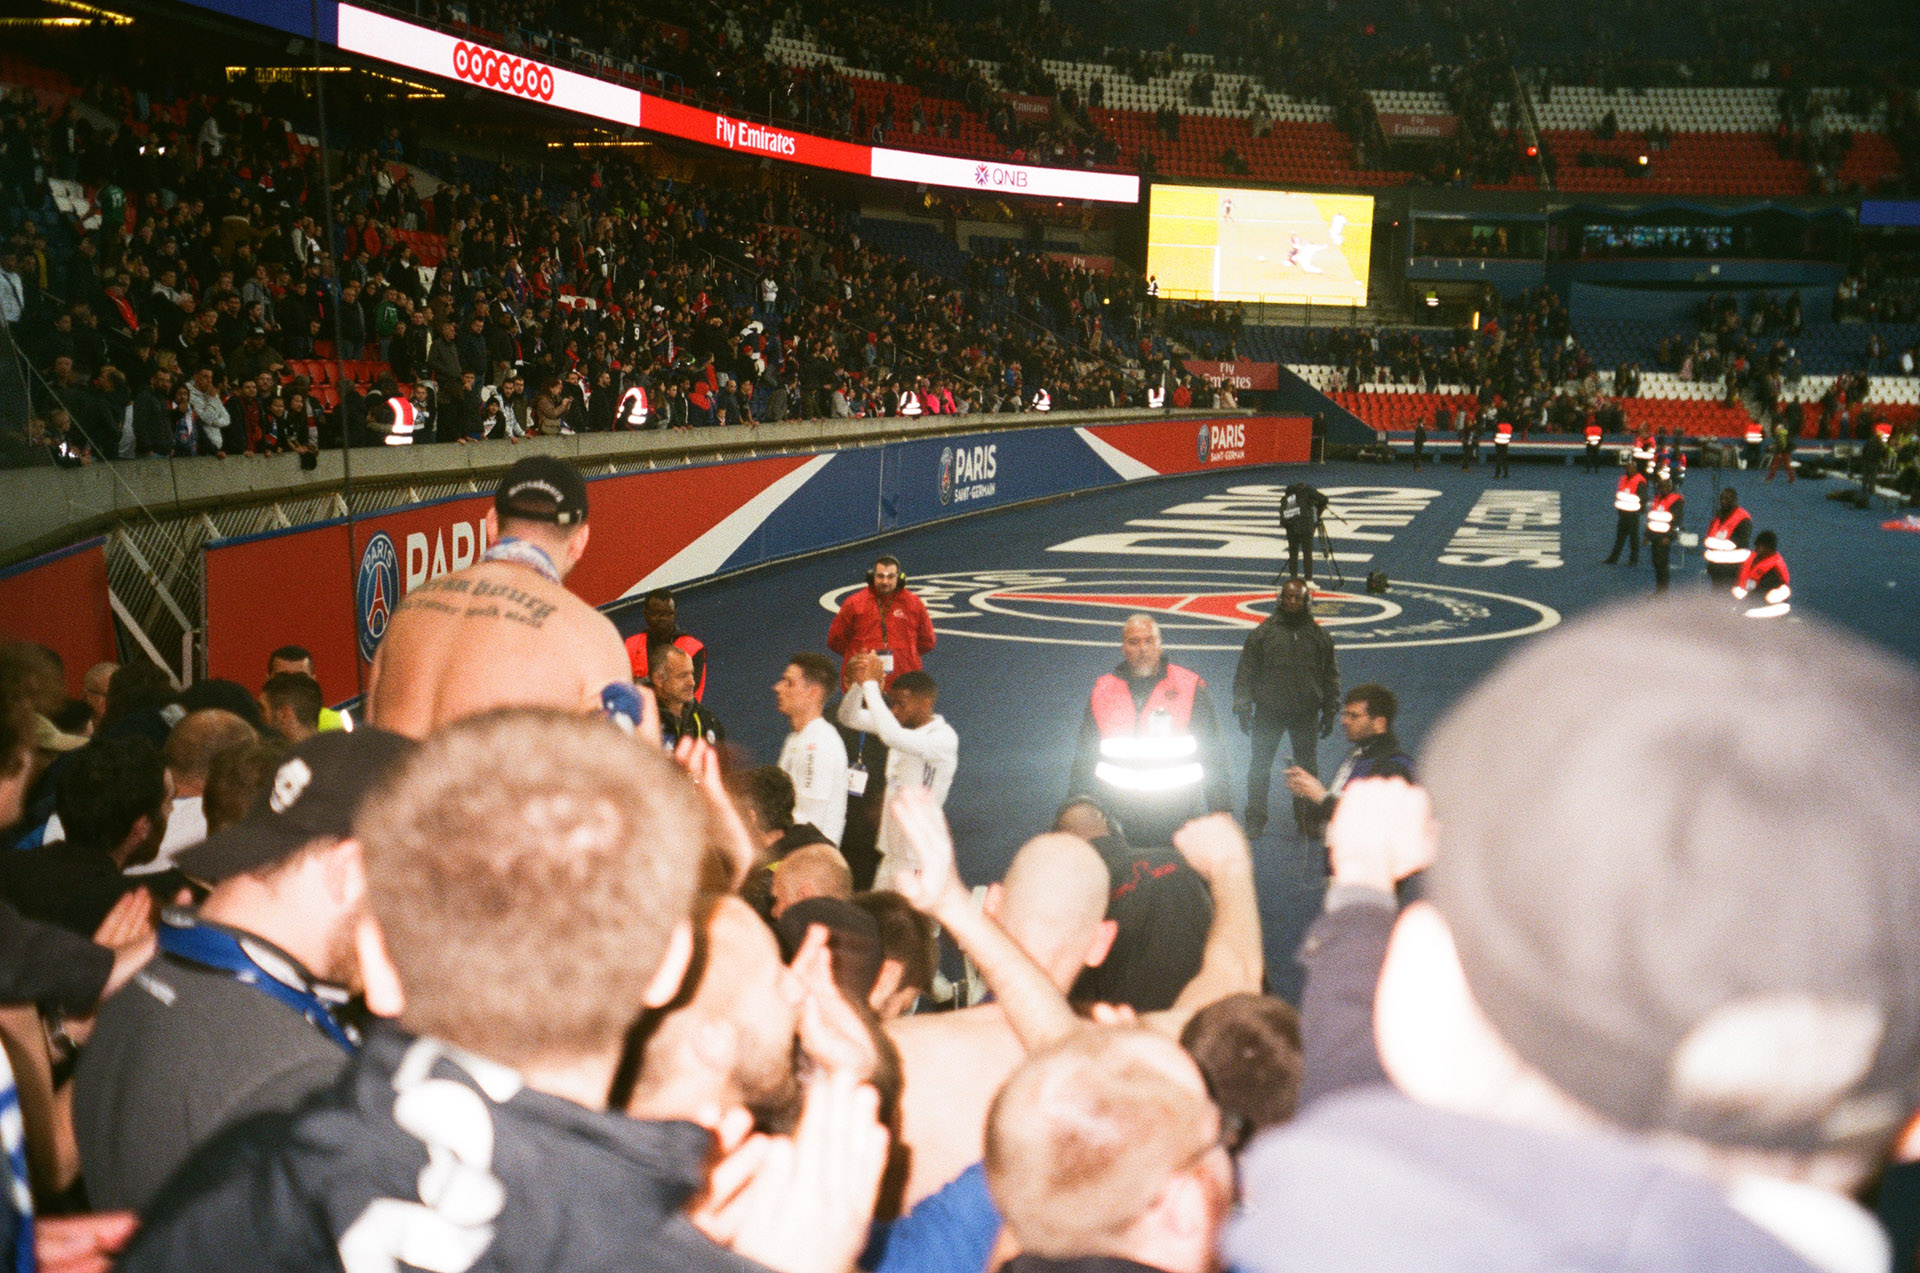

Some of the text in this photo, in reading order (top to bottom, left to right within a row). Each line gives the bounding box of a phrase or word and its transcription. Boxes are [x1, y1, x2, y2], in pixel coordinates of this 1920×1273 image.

[453, 41, 554, 101] ooredoo
[716, 116, 795, 155] Fly Emirates
[992, 168, 1028, 187] QNB
[1220, 362, 1235, 375] Fly
[1211, 424, 1246, 450] PARIS
[955, 444, 997, 484] PARIS
[954, 482, 996, 504] SAINT-GERMAIN
[364, 540, 394, 574] PARIS
